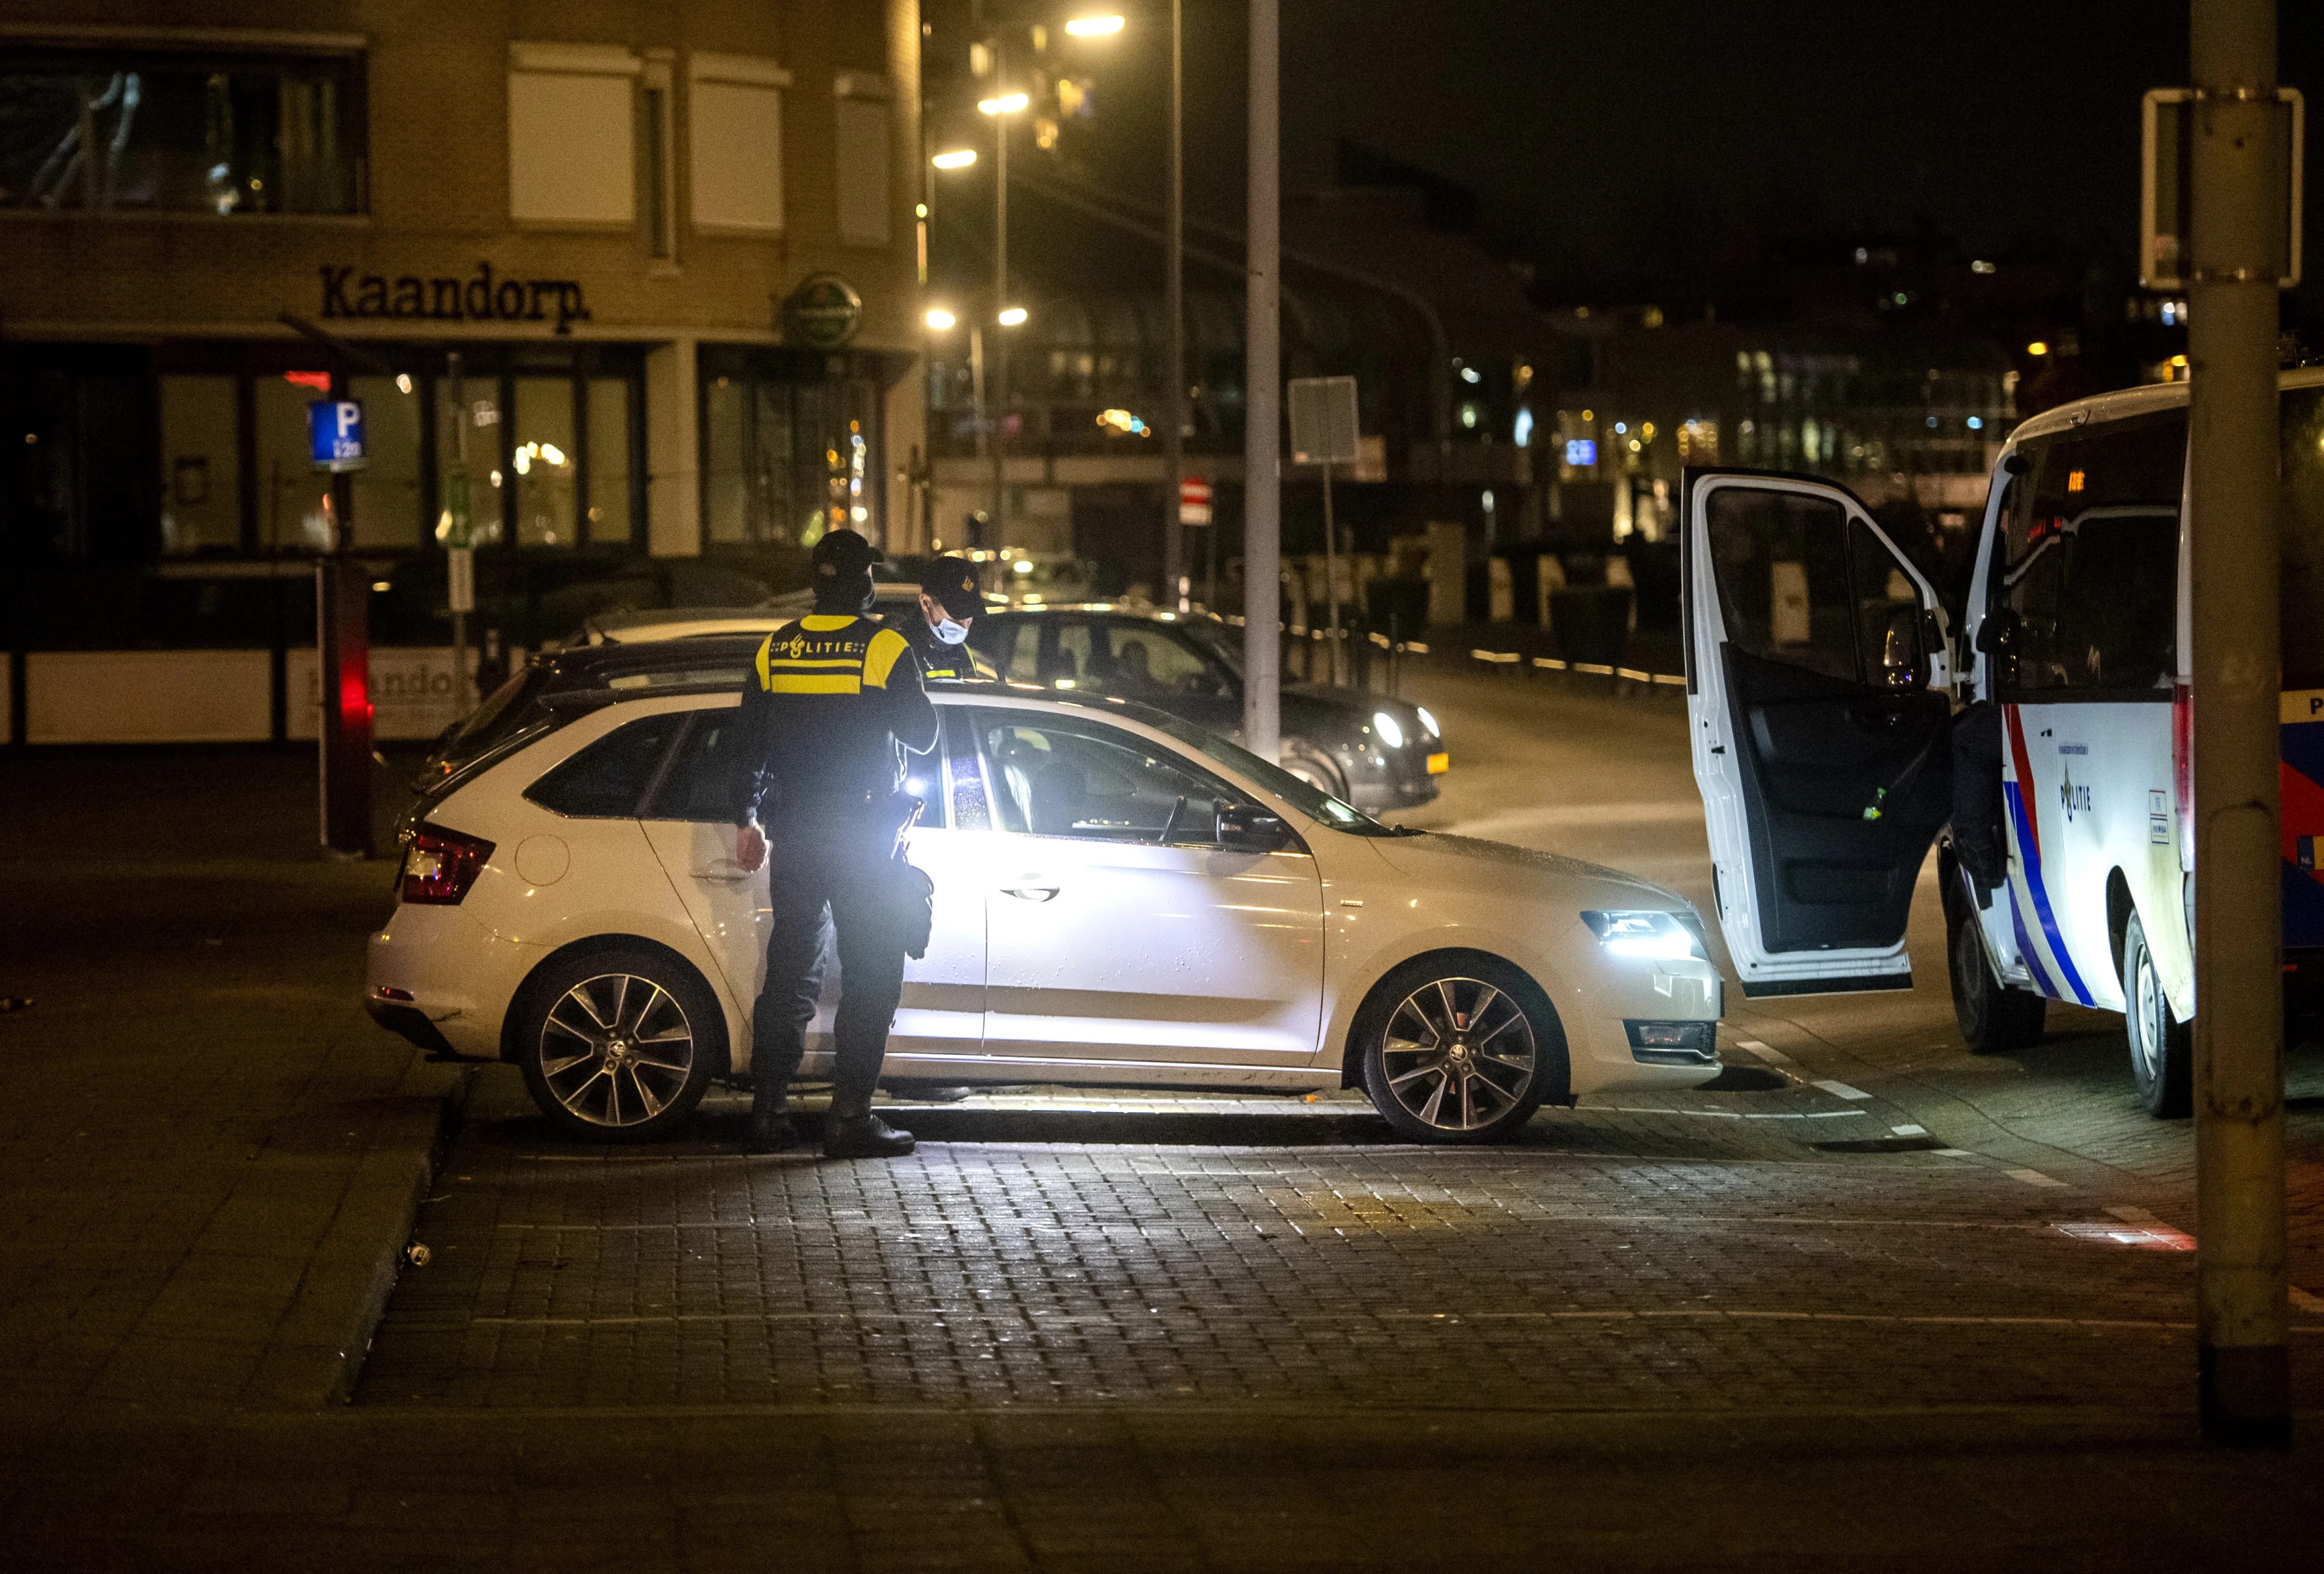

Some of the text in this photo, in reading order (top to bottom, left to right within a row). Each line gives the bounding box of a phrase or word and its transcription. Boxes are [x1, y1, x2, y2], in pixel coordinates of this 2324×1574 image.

[336, 402, 360, 437] P
[780, 640, 853, 658] POLITIE
[2060, 785, 2091, 822] POLITIE
[2300, 856, 2313, 866] NL
